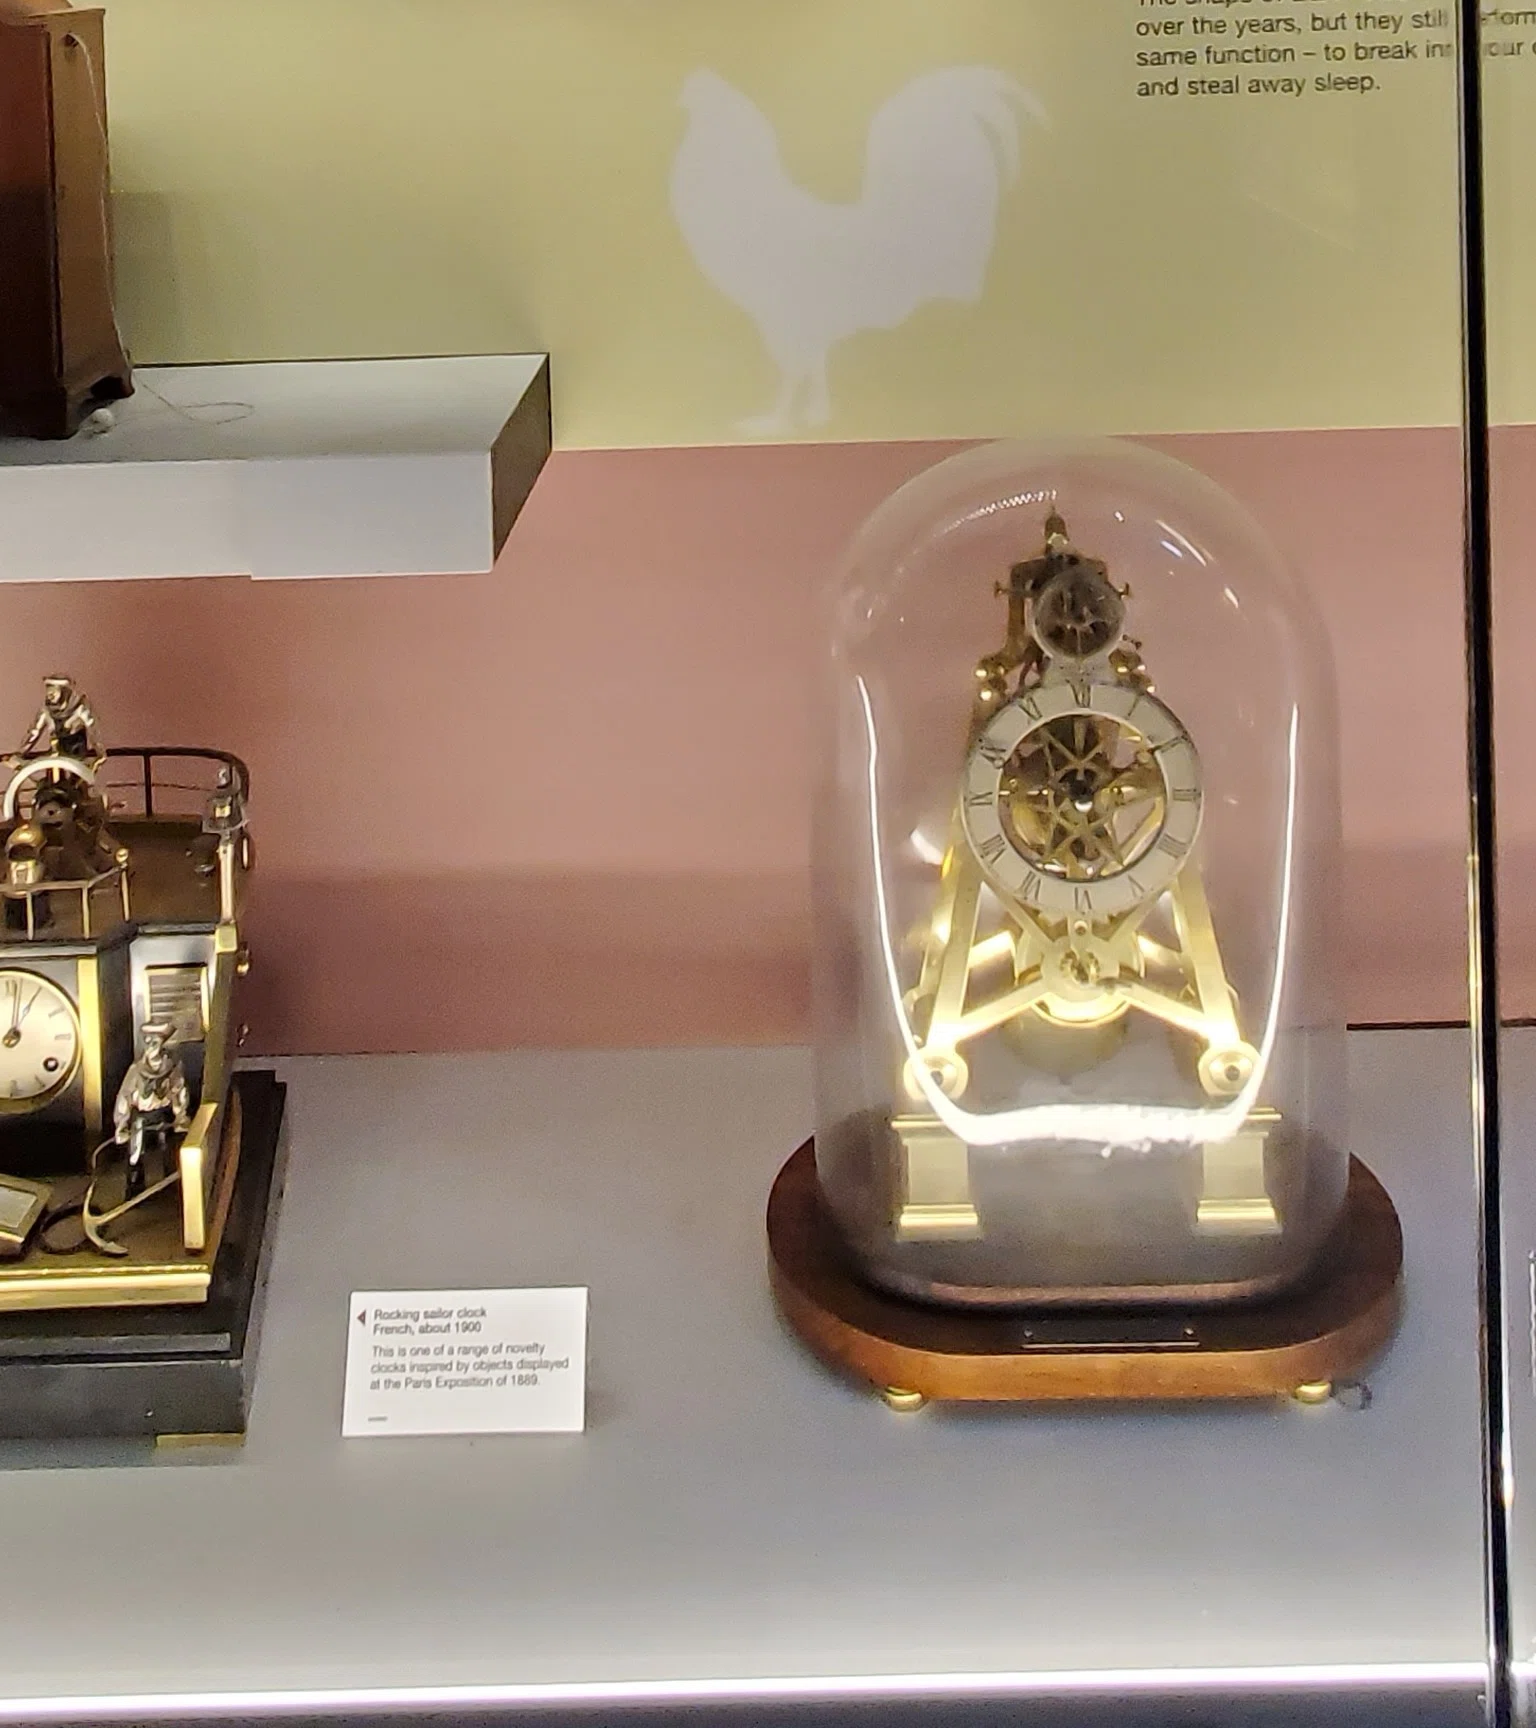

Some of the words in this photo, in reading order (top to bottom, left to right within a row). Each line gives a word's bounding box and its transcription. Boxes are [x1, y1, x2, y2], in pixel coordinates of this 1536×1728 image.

[1136, 19, 1185, 36] over
[1193, 15, 1228, 34] the
[1235, 15, 1302, 38] years,
[1311, 12, 1347, 31] but
[1355, 11, 1404, 32] they
[1136, 49, 1197, 67] same
[1205, 45, 1296, 65] function
[1324, 43, 1346, 61] to
[1355, 41, 1418, 61] break
[1137, 77, 1179, 96] and
[1186, 75, 1240, 95] steal
[1248, 76, 1306, 97] away
[1314, 72, 1381, 94] sleep.
[374, 1309, 420, 1321] Rocking
[423, 1308, 453, 1319] sailor
[457, 1307, 487, 1318] clock
[373, 1323, 415, 1336] French,
[418, 1323, 451, 1334] about
[372, 1345, 394, 1357] This
[398, 1346, 407, 1357] is
[410, 1345, 431, 1356] one
[433, 1344, 445, 1356] of
[448, 1346, 455, 1356] a
[457, 1345, 489, 1357] range
[492, 1342, 503, 1355] of
[506, 1342, 545, 1355] novelty
[370, 1361, 406, 1374] clocks
[409, 1360, 453, 1374] inspired
[456, 1360, 470, 1373] by
[473, 1359, 513, 1372] objects
[517, 1358, 569, 1370] displayed
[370, 1378, 380, 1390] at
[384, 1377, 401, 1389] the
[405, 1377, 432, 1389] Paris
[435, 1376, 493, 1390] Exposition
[496, 1375, 507, 1386] of
